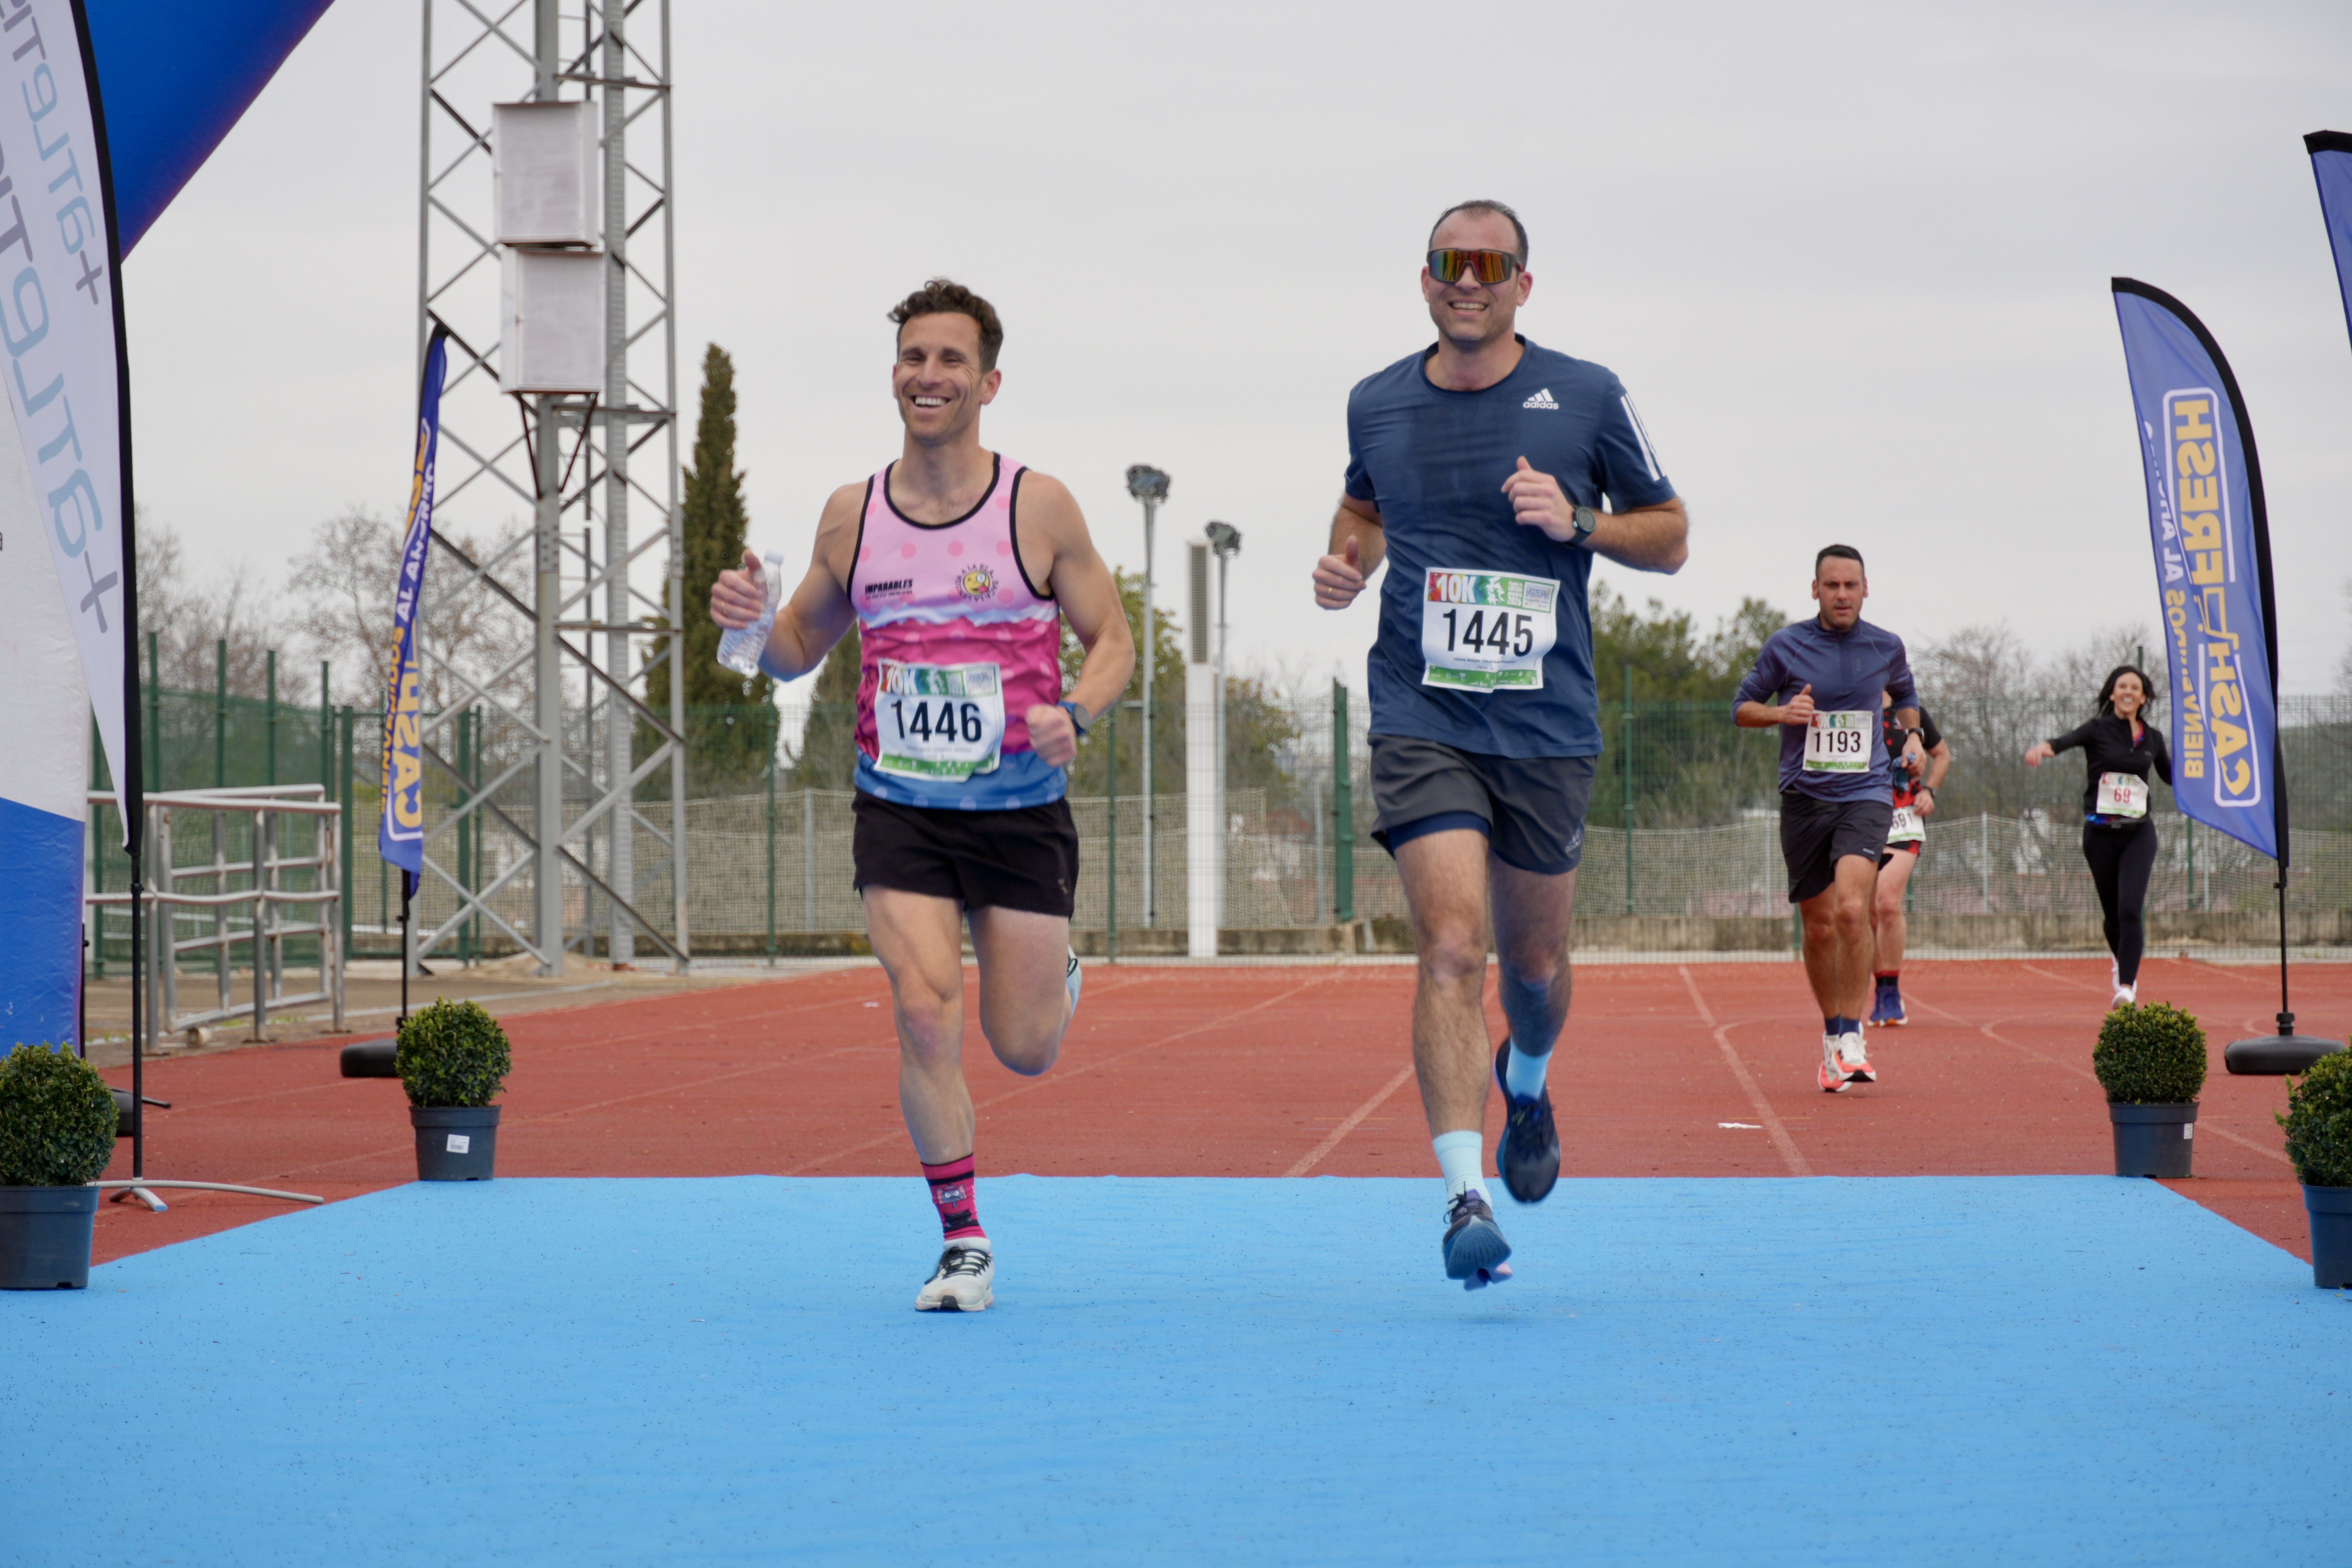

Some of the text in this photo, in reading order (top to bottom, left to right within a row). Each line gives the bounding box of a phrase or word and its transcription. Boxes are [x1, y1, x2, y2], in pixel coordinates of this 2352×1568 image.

[1523, 401, 1559, 410] adidas
[1437, 575, 1476, 603] 10K
[396, 587, 413, 622] AL
[1443, 609, 1533, 657] 1445
[891, 699, 982, 742] 1446
[1814, 731, 1860, 752] 1193
[2114, 787, 2131, 803] 69
